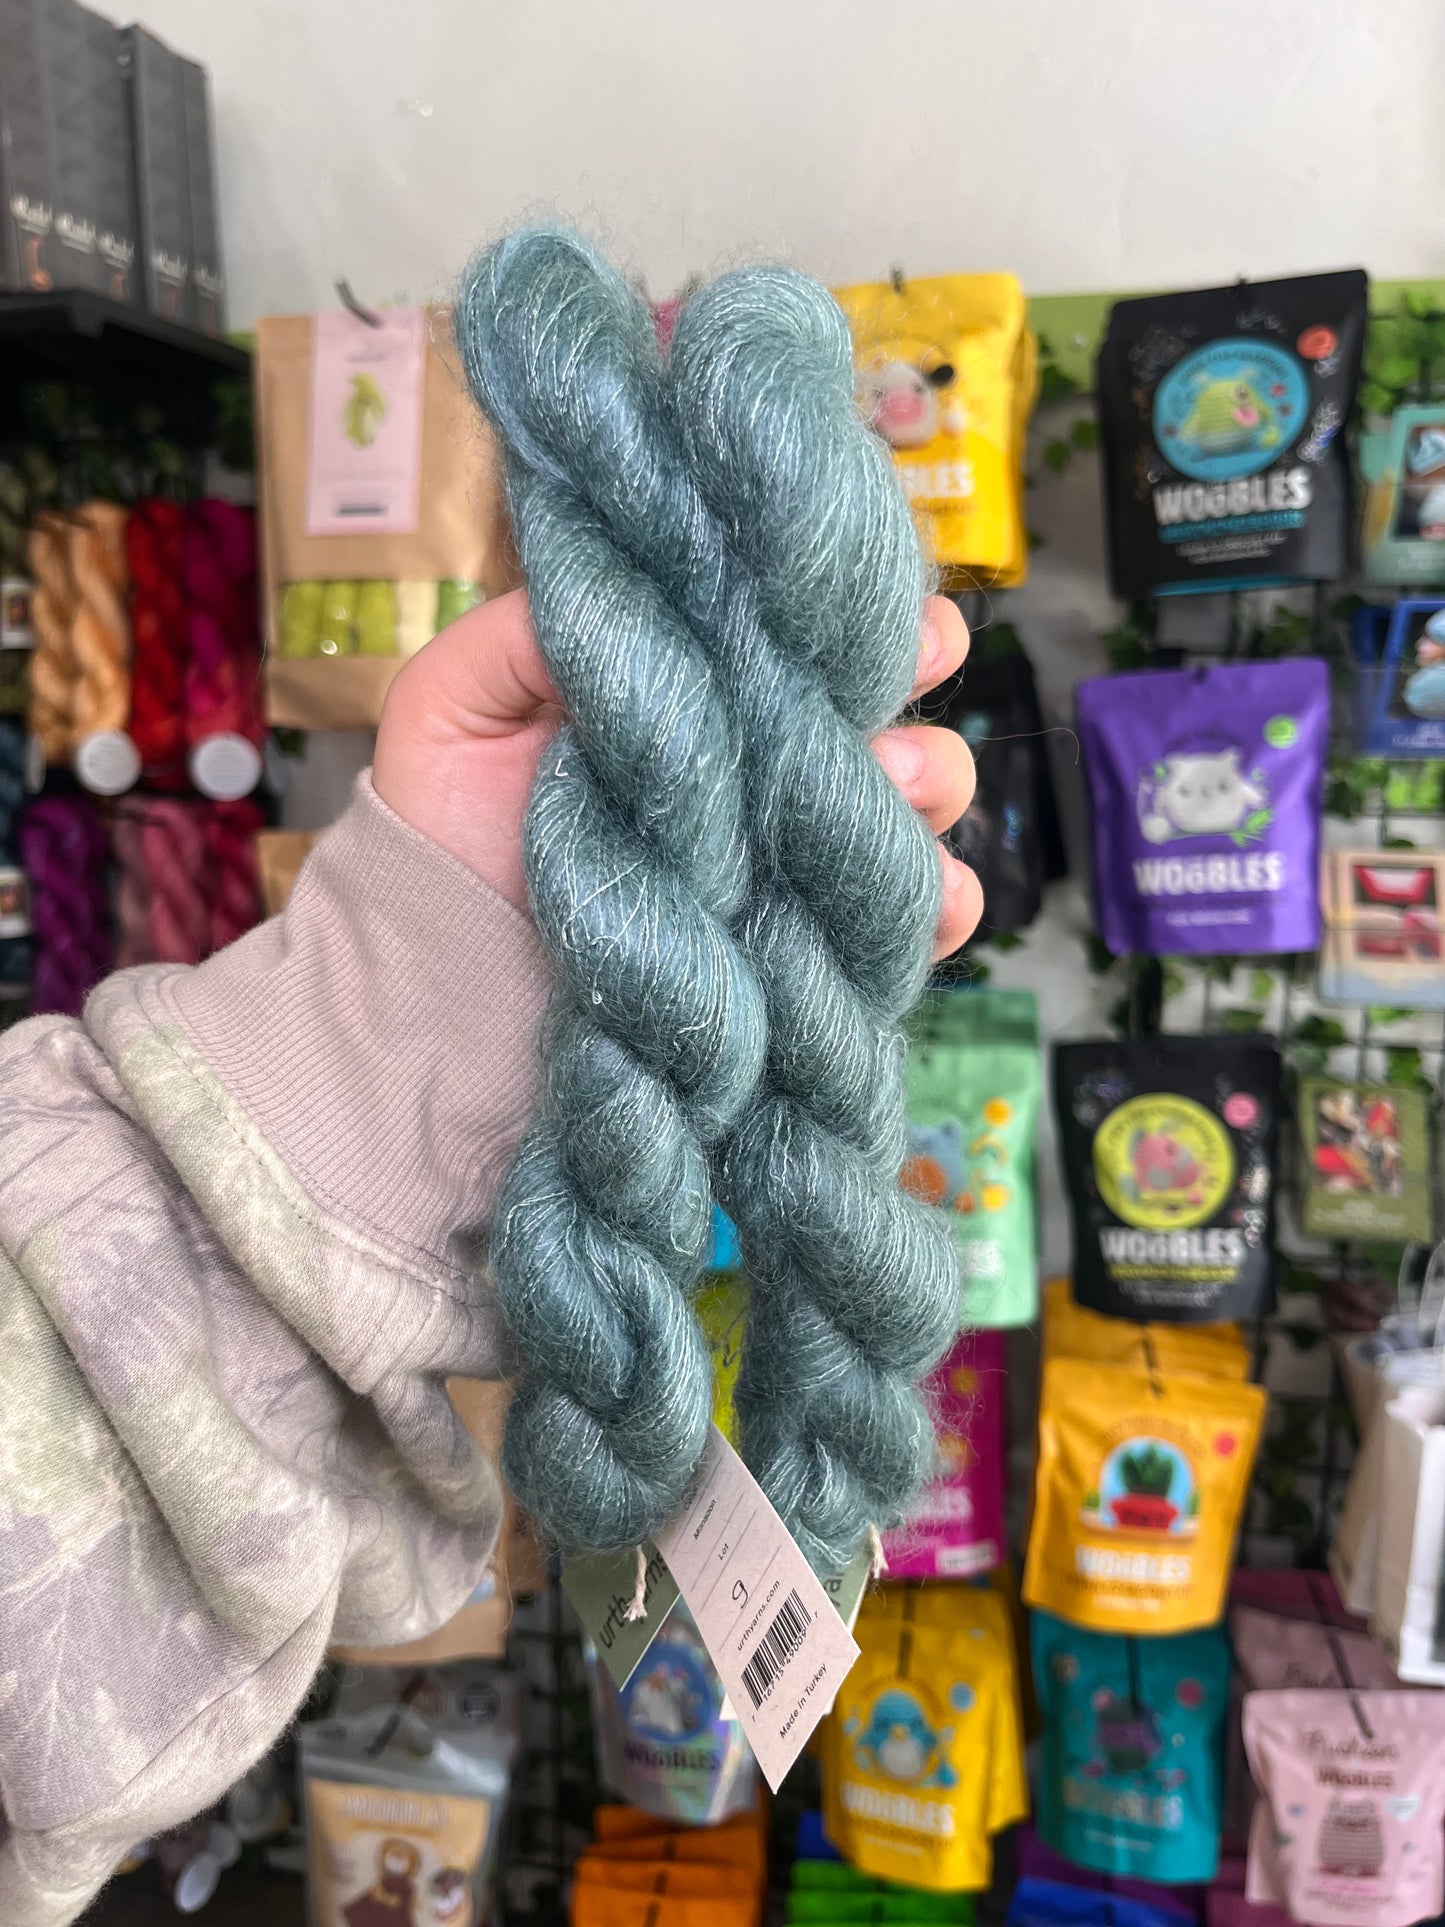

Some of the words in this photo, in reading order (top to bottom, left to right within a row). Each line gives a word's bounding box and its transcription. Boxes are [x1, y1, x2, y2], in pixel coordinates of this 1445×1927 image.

[718, 1543, 729, 1560] Lot
[737, 1580, 780, 1651] urthyarns.com
[779, 1710, 799, 1739] Made
[799, 1697, 807, 1710] in
[804, 1663, 828, 1697] Turkey
